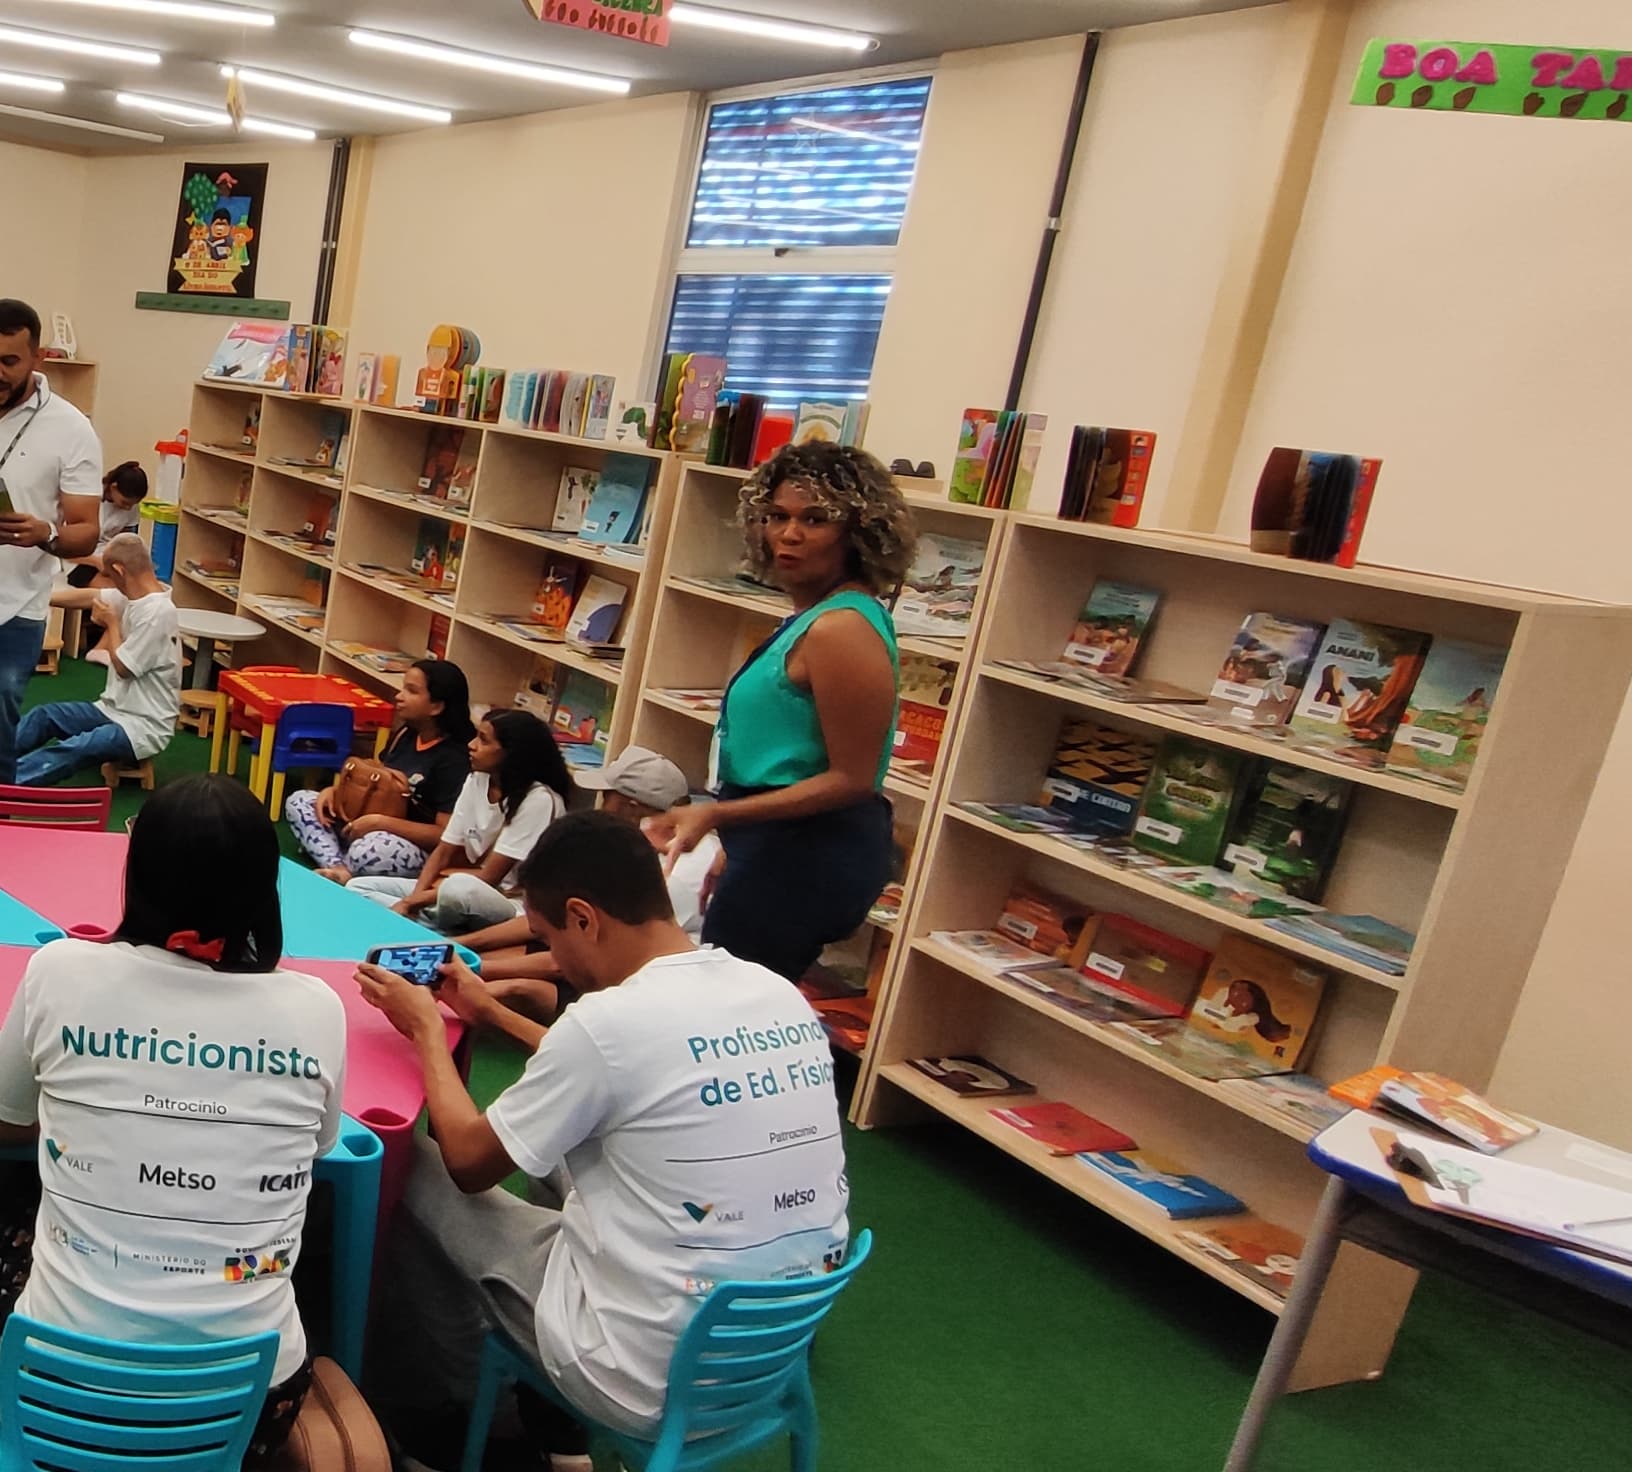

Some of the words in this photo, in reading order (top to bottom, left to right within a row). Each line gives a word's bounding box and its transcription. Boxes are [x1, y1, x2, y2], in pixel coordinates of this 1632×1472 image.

[1378, 43, 1498, 85] BOA
[61, 1024, 322, 1080] Nutricionista
[688, 1020, 822, 1063] Profissiona
[700, 1078, 742, 1107] de
[746, 1067, 786, 1099] Ed.
[788, 1056, 834, 1090] Físic
[65, 1156, 94, 1174] VALE
[139, 1162, 216, 1191] Metso
[715, 1210, 744, 1223] VALE
[774, 1187, 816, 1212] Metso
